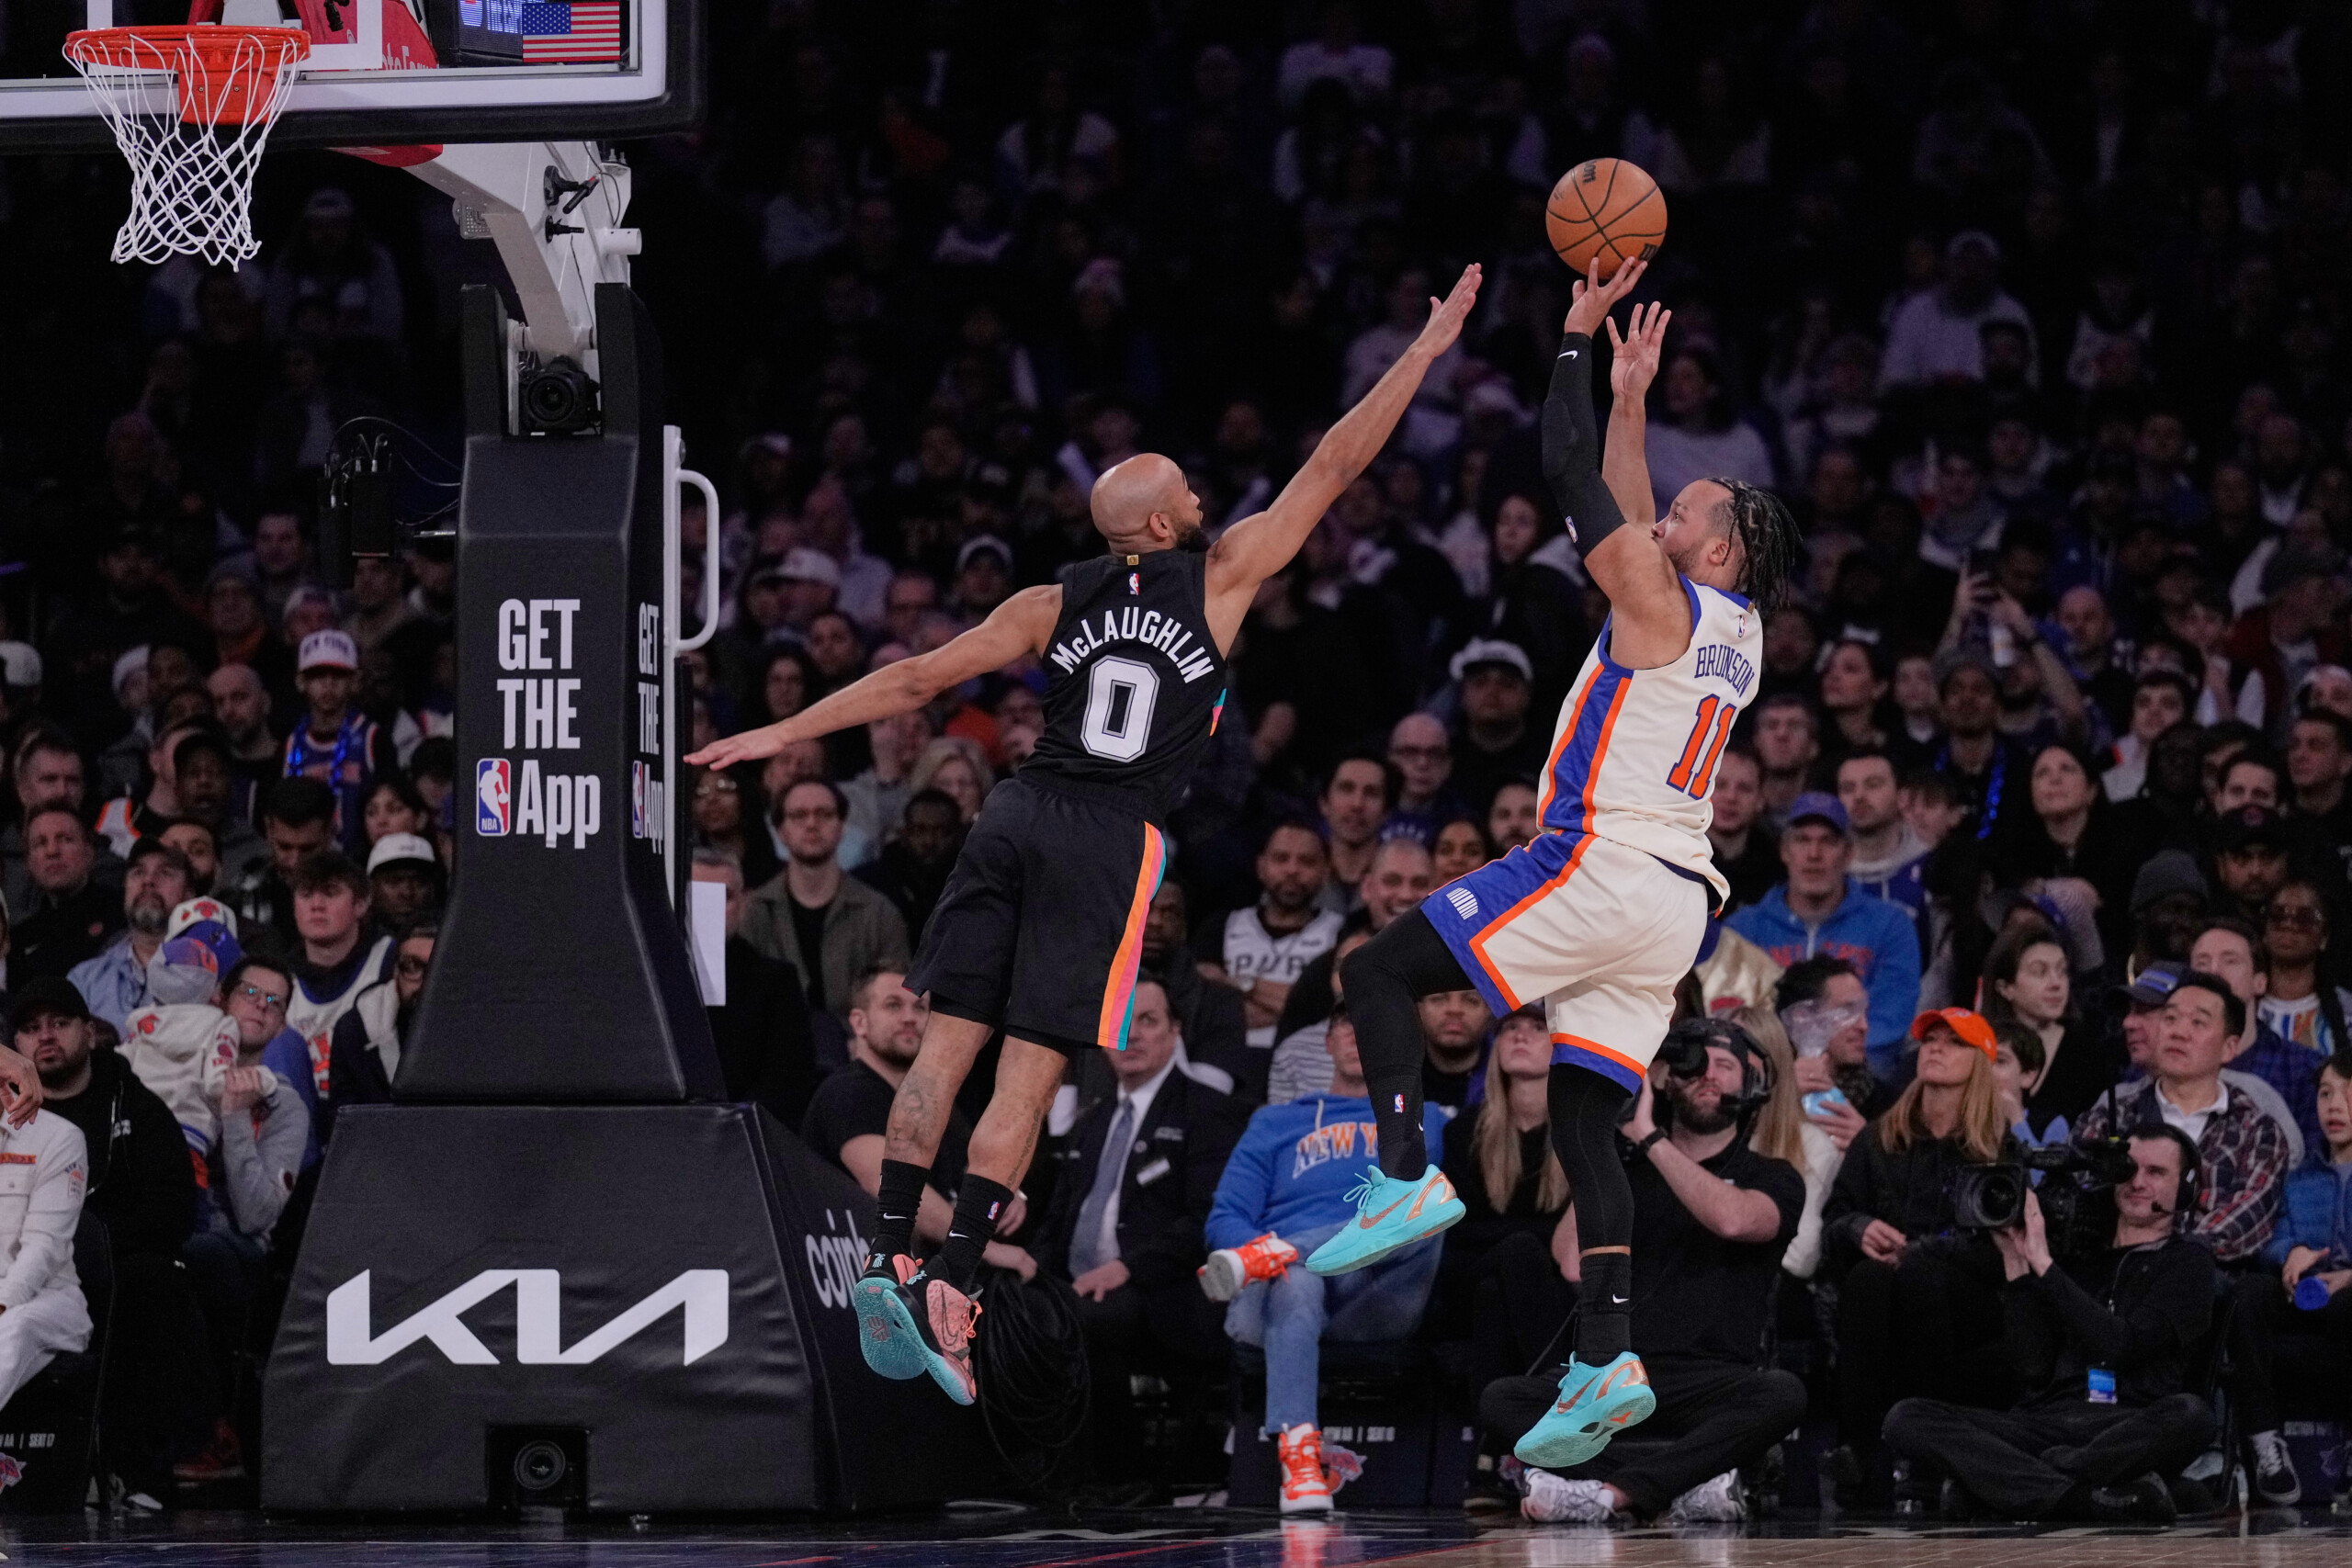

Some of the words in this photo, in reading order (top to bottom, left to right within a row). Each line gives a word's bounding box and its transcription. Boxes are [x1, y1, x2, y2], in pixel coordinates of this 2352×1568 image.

[498, 598, 581, 671] GET
[638, 601, 660, 676] GET
[1050, 606, 1215, 684] McLAUGHLIN
[1694, 644, 1755, 698] BRUNSON
[497, 678, 581, 750] THE
[638, 681, 660, 756] THE
[1080, 654, 1161, 763] 0
[1666, 694, 1737, 801] 11
[481, 817, 498, 831] NBA
[515, 759, 601, 850] App
[643, 763, 663, 855] App
[326, 1268, 729, 1367] KIA
